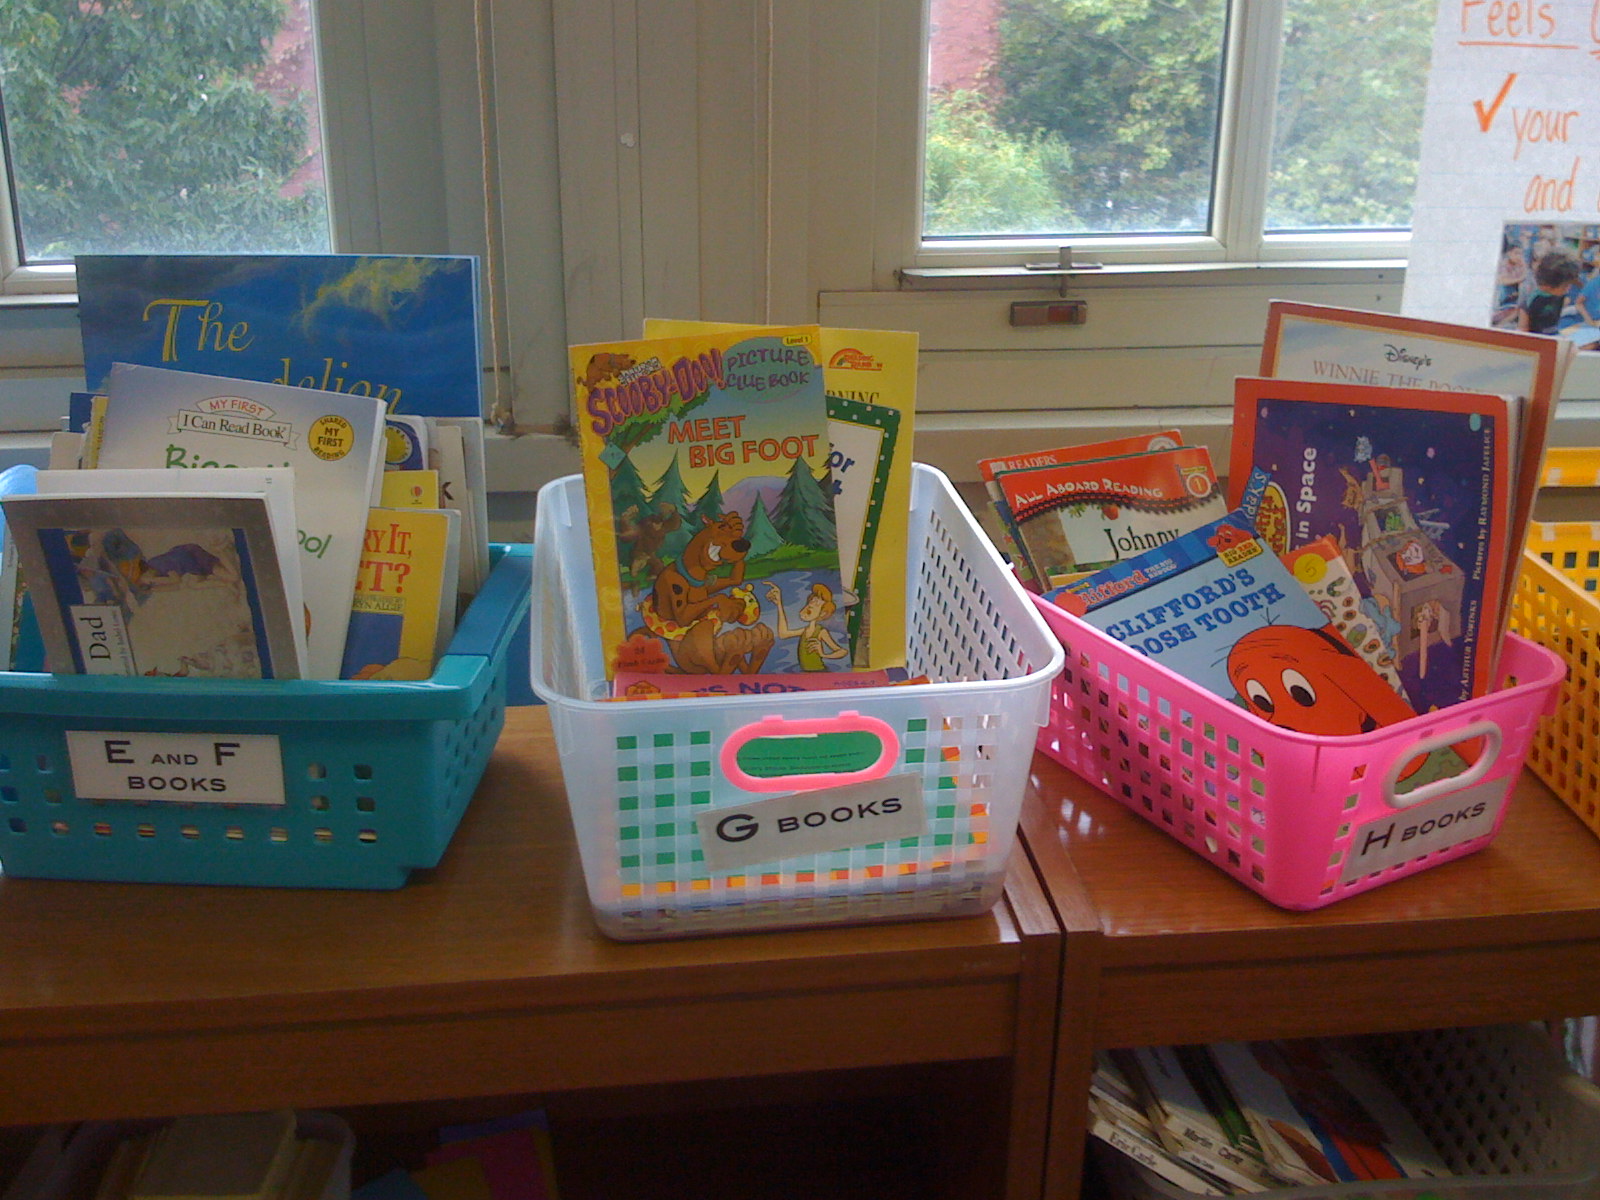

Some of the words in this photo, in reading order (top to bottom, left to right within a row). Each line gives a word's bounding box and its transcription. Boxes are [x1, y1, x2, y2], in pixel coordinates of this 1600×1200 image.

[1512, 107, 1581, 161] your
[1523, 155, 1581, 214] and
[142, 299, 255, 363] The
[727, 349, 811, 372] PICTURE
[1313, 360, 1381, 385] WINNIE
[726, 373, 767, 391] CLUE
[768, 371, 810, 388] BOOK
[209, 399, 228, 411] MY
[231, 399, 266, 416] FIRST
[183, 414, 189, 427] I
[192, 415, 216, 430] Can
[220, 419, 250, 434] Read
[324, 427, 340, 437] MY
[667, 415, 747, 446] MEET
[317, 436, 344, 448] FIRST
[690, 443, 736, 469] BIG
[742, 434, 820, 463] FOOT
[1015, 489, 1044, 508] ALL
[1046, 481, 1100, 496] ABOARD
[1102, 477, 1163, 499] READING
[1296, 447, 1317, 514] Space
[1105, 568, 1256, 642] CLIFFORD'S
[1194, 582, 1286, 632] TOOTH
[80, 616, 111, 660] Dad
[104, 739, 135, 764] E
[151, 752, 199, 766] AND
[214, 742, 241, 766] F
[127, 775, 228, 792] BOOKS
[716, 813, 759, 842] G
[777, 797, 903, 834] BOOKS
[1360, 822, 1396, 856] H
[1399, 801, 1487, 842] BOOKS
